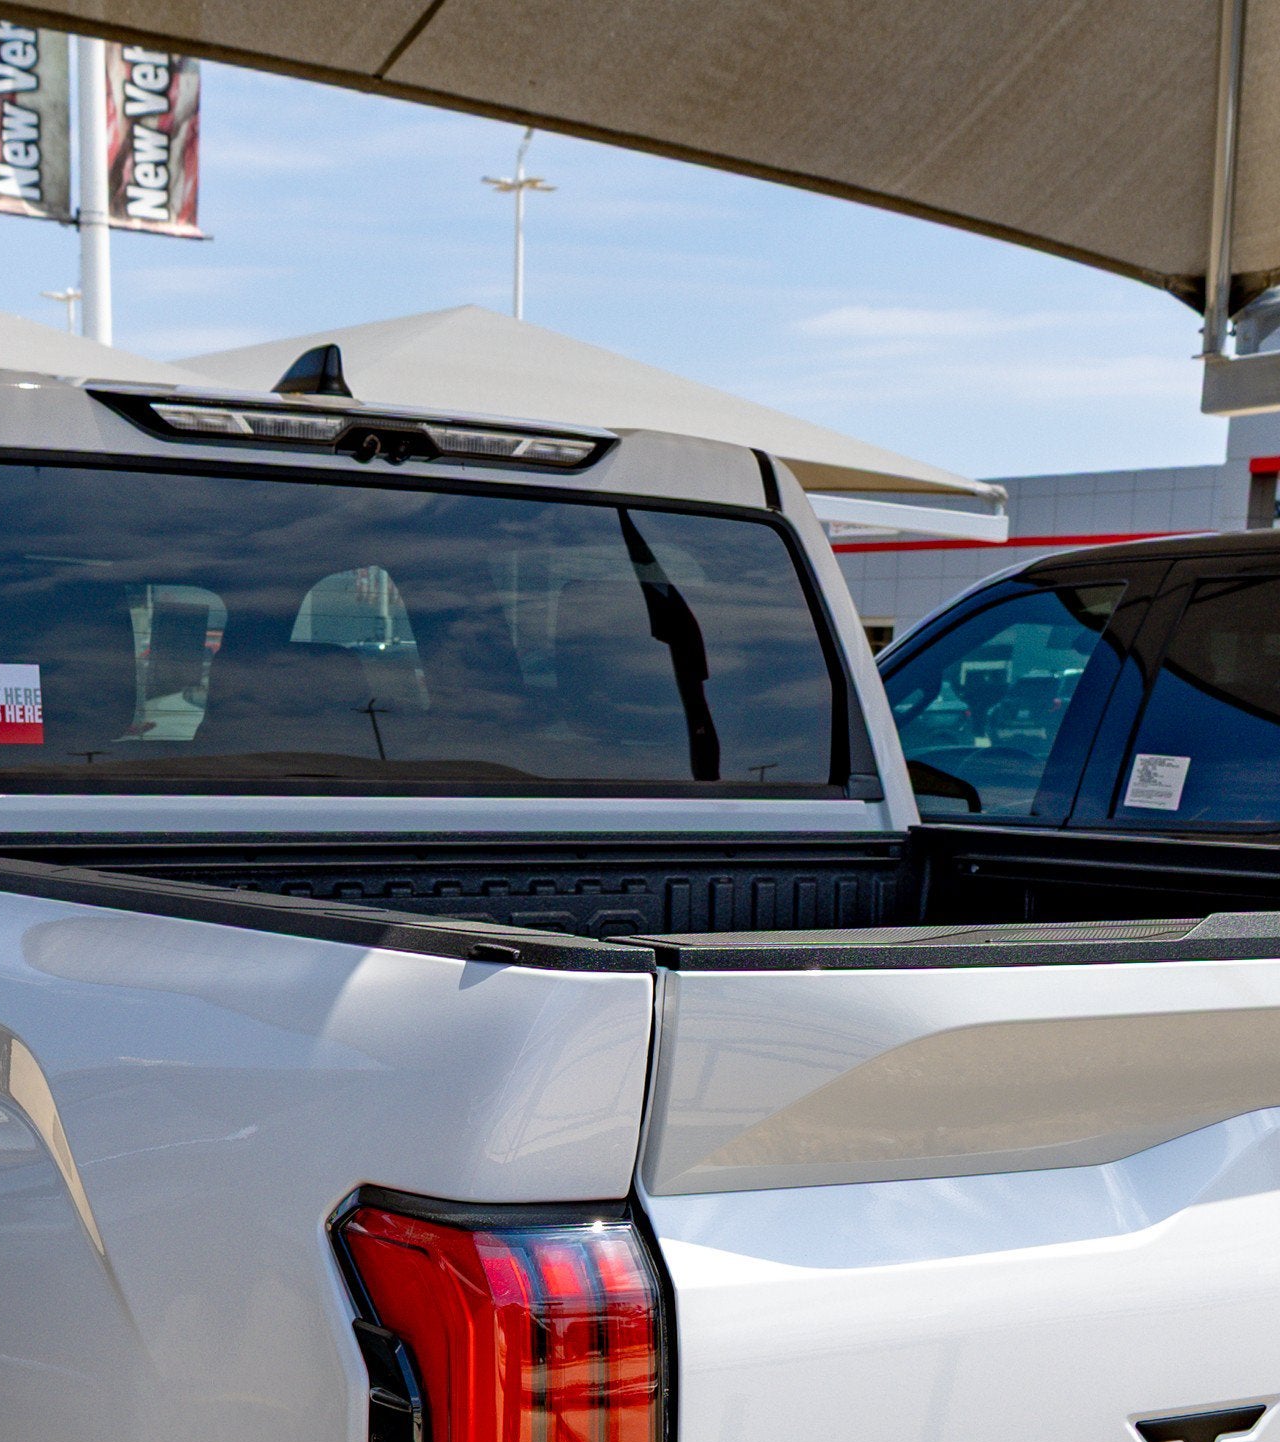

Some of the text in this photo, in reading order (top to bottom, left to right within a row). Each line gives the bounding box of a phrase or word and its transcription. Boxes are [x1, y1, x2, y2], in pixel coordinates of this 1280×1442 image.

[126, 125, 170, 220] New
[4, 688, 42, 705] HERE
[5, 704, 43, 723] HERE
